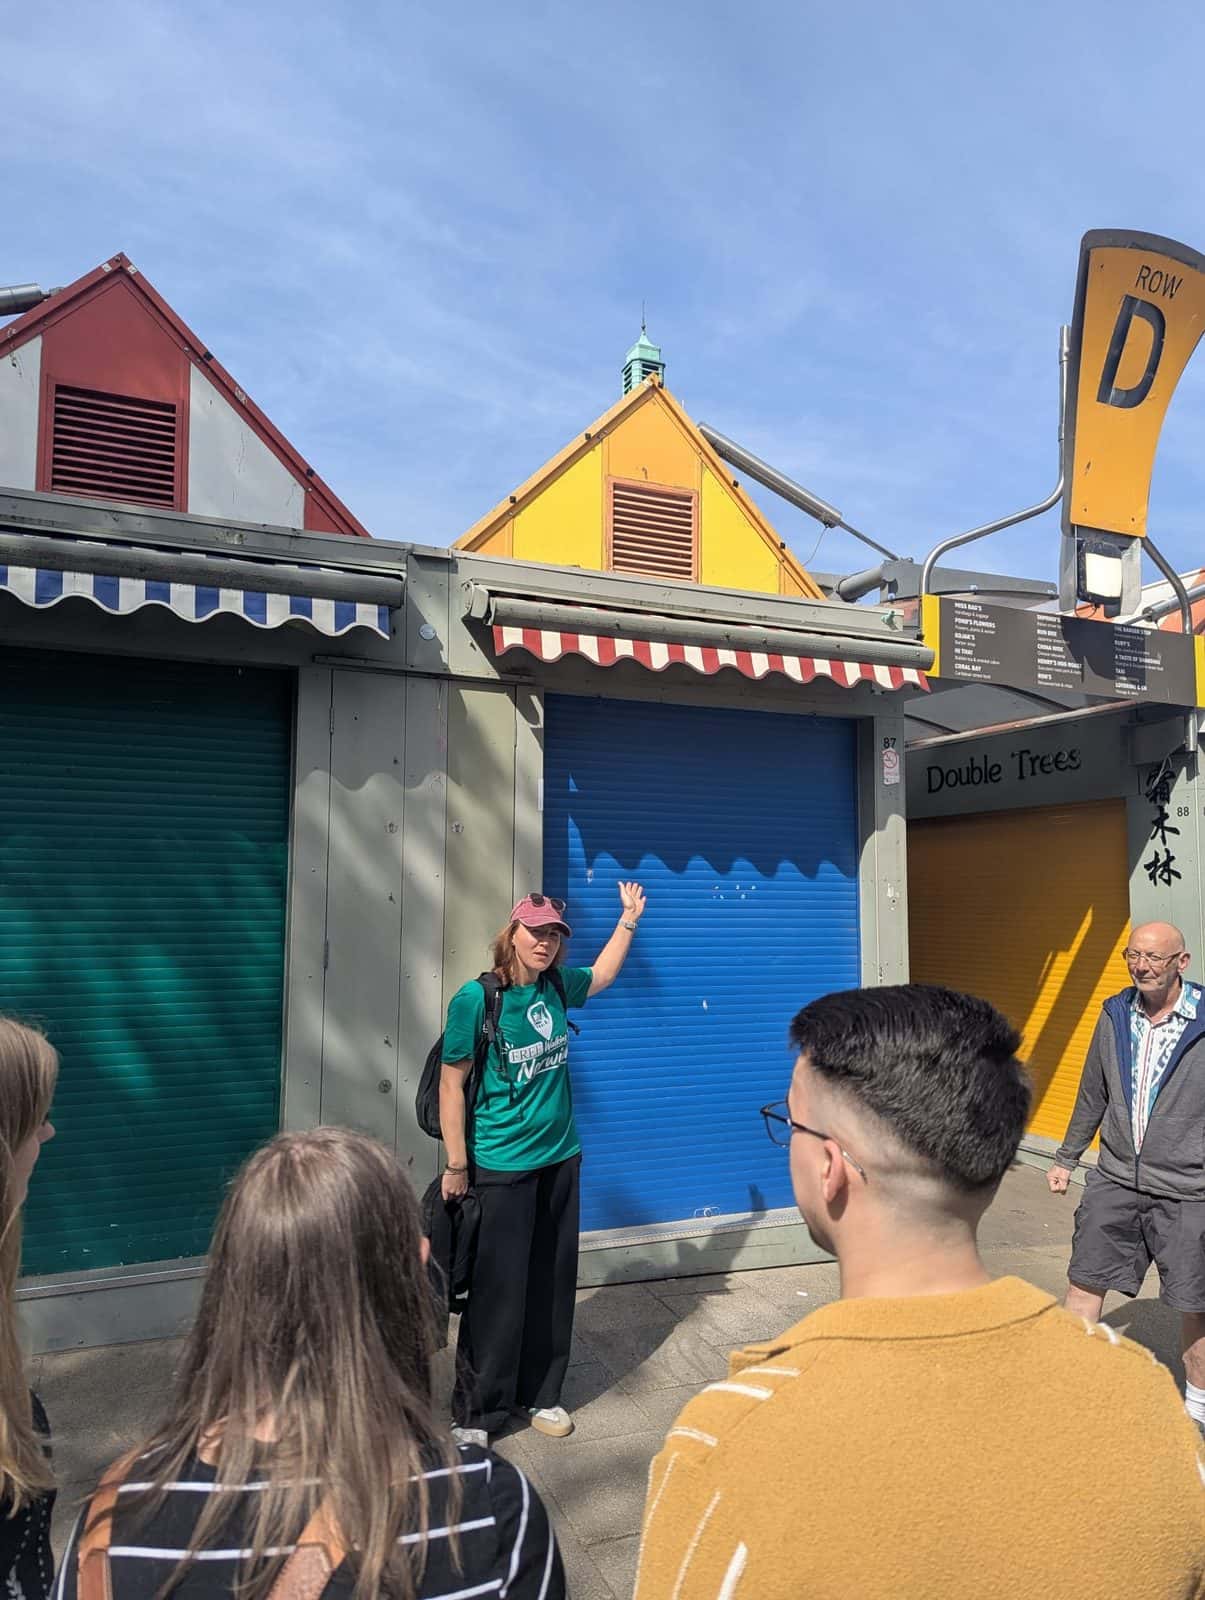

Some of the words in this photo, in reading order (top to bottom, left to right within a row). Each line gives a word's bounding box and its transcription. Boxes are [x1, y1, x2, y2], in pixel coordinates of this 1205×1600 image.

[1136, 265, 1183, 299] ROW
[1096, 294, 1166, 408] D
[884, 737, 897, 749] 87
[927, 755, 1002, 793] Double
[1011, 749, 1081, 780] Trees
[1177, 806, 1190, 817] 88
[512, 1043, 543, 1061] FREE
